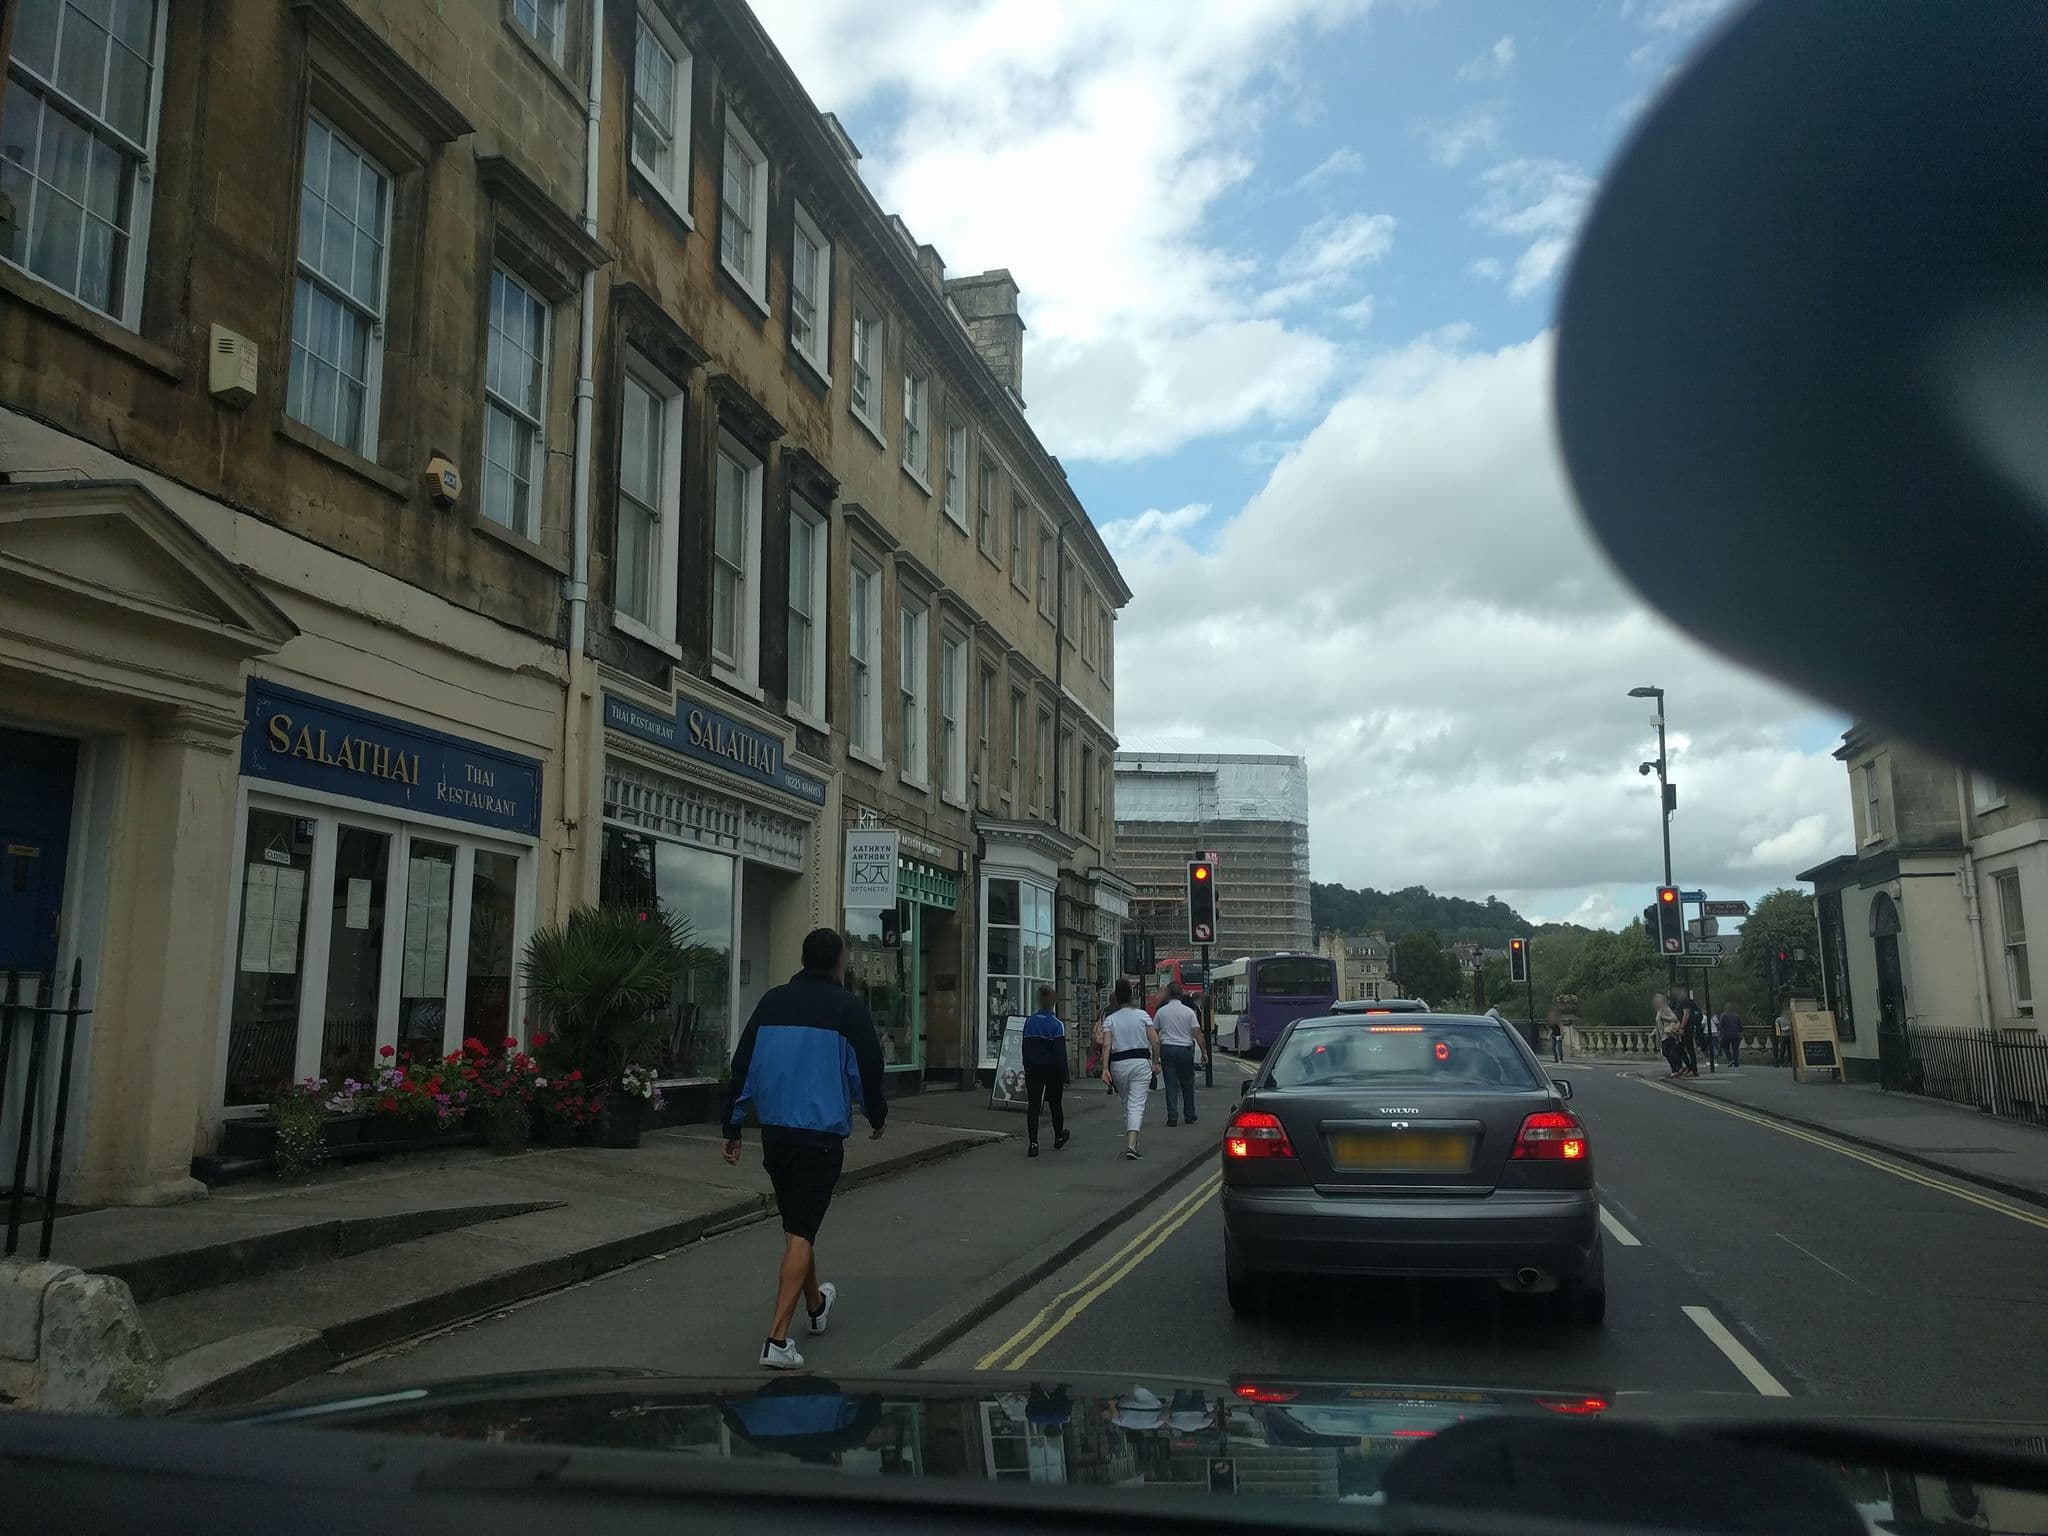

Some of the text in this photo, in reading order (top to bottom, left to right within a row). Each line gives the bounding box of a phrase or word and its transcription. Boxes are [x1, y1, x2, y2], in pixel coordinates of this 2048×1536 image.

[612, 704, 674, 740] THAI RESTAURANT
[268, 713, 421, 786] SALATHAI
[689, 709, 776, 776] SALATHAI
[465, 764, 495, 787] THAI
[437, 782, 517, 816] RESTAURANT
